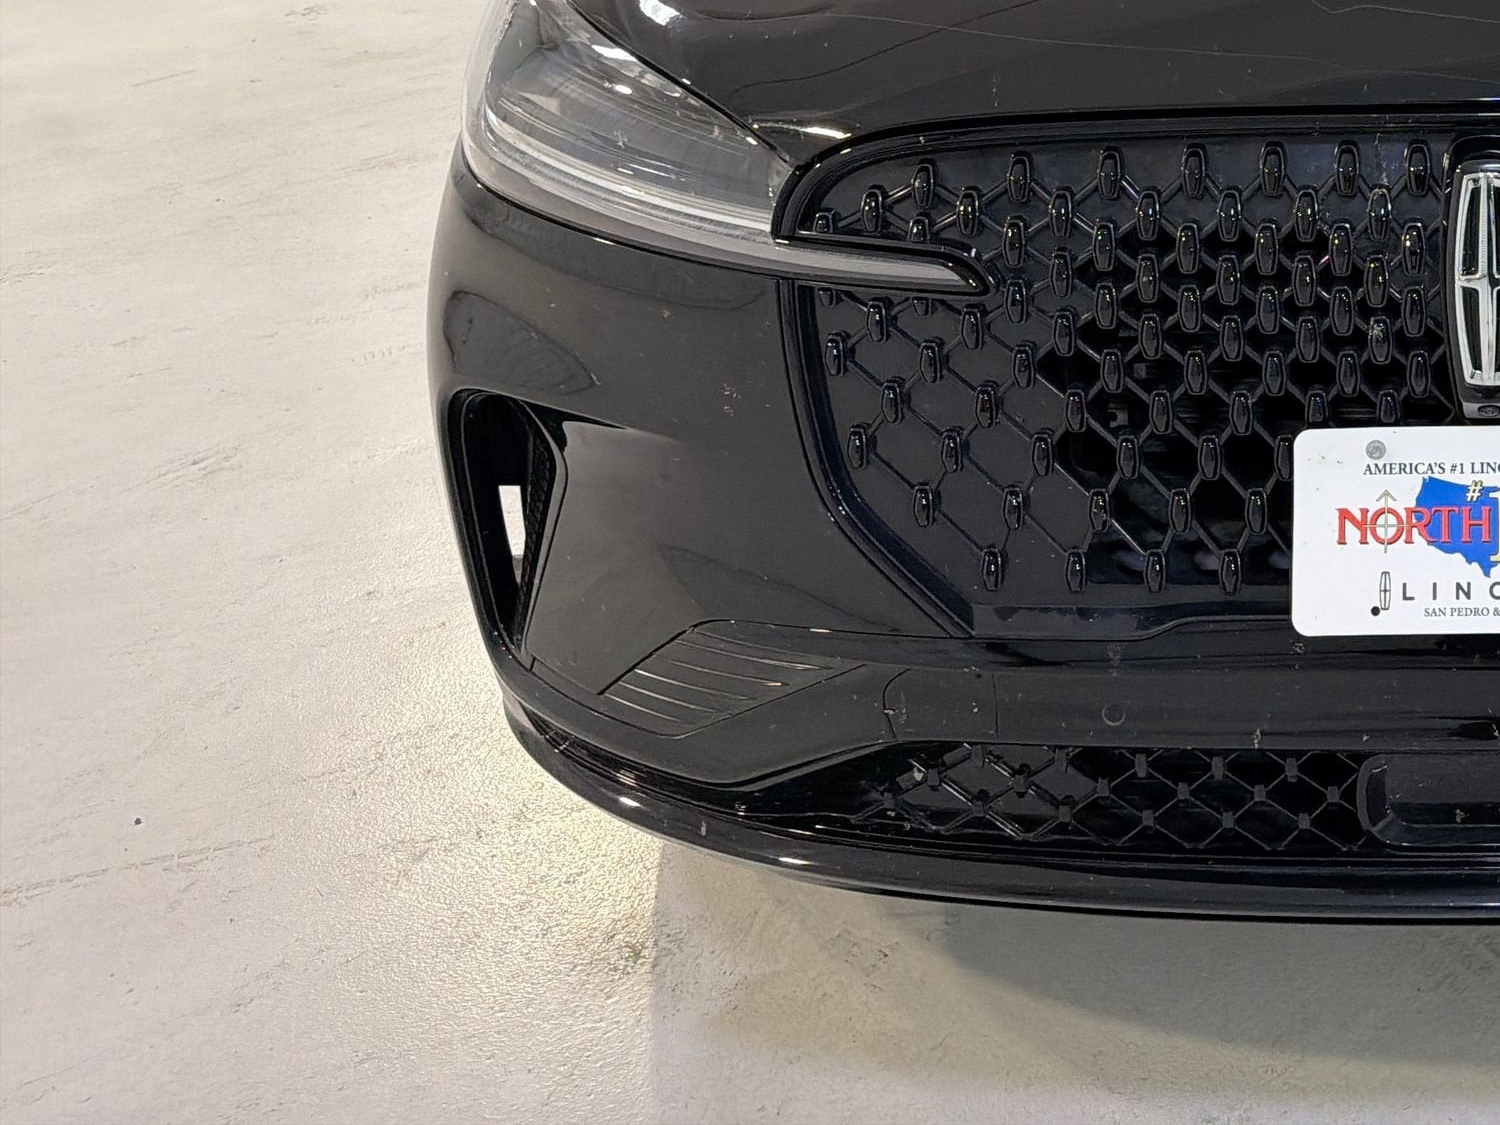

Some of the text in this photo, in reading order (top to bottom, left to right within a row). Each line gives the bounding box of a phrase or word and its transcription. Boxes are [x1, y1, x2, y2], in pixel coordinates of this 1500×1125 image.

[1450, 462, 1465, 475] #1
[1335, 506, 1492, 545] NORTH
[1424, 607, 1448, 617] SAN
[1450, 607, 1490, 617] PEDRO
